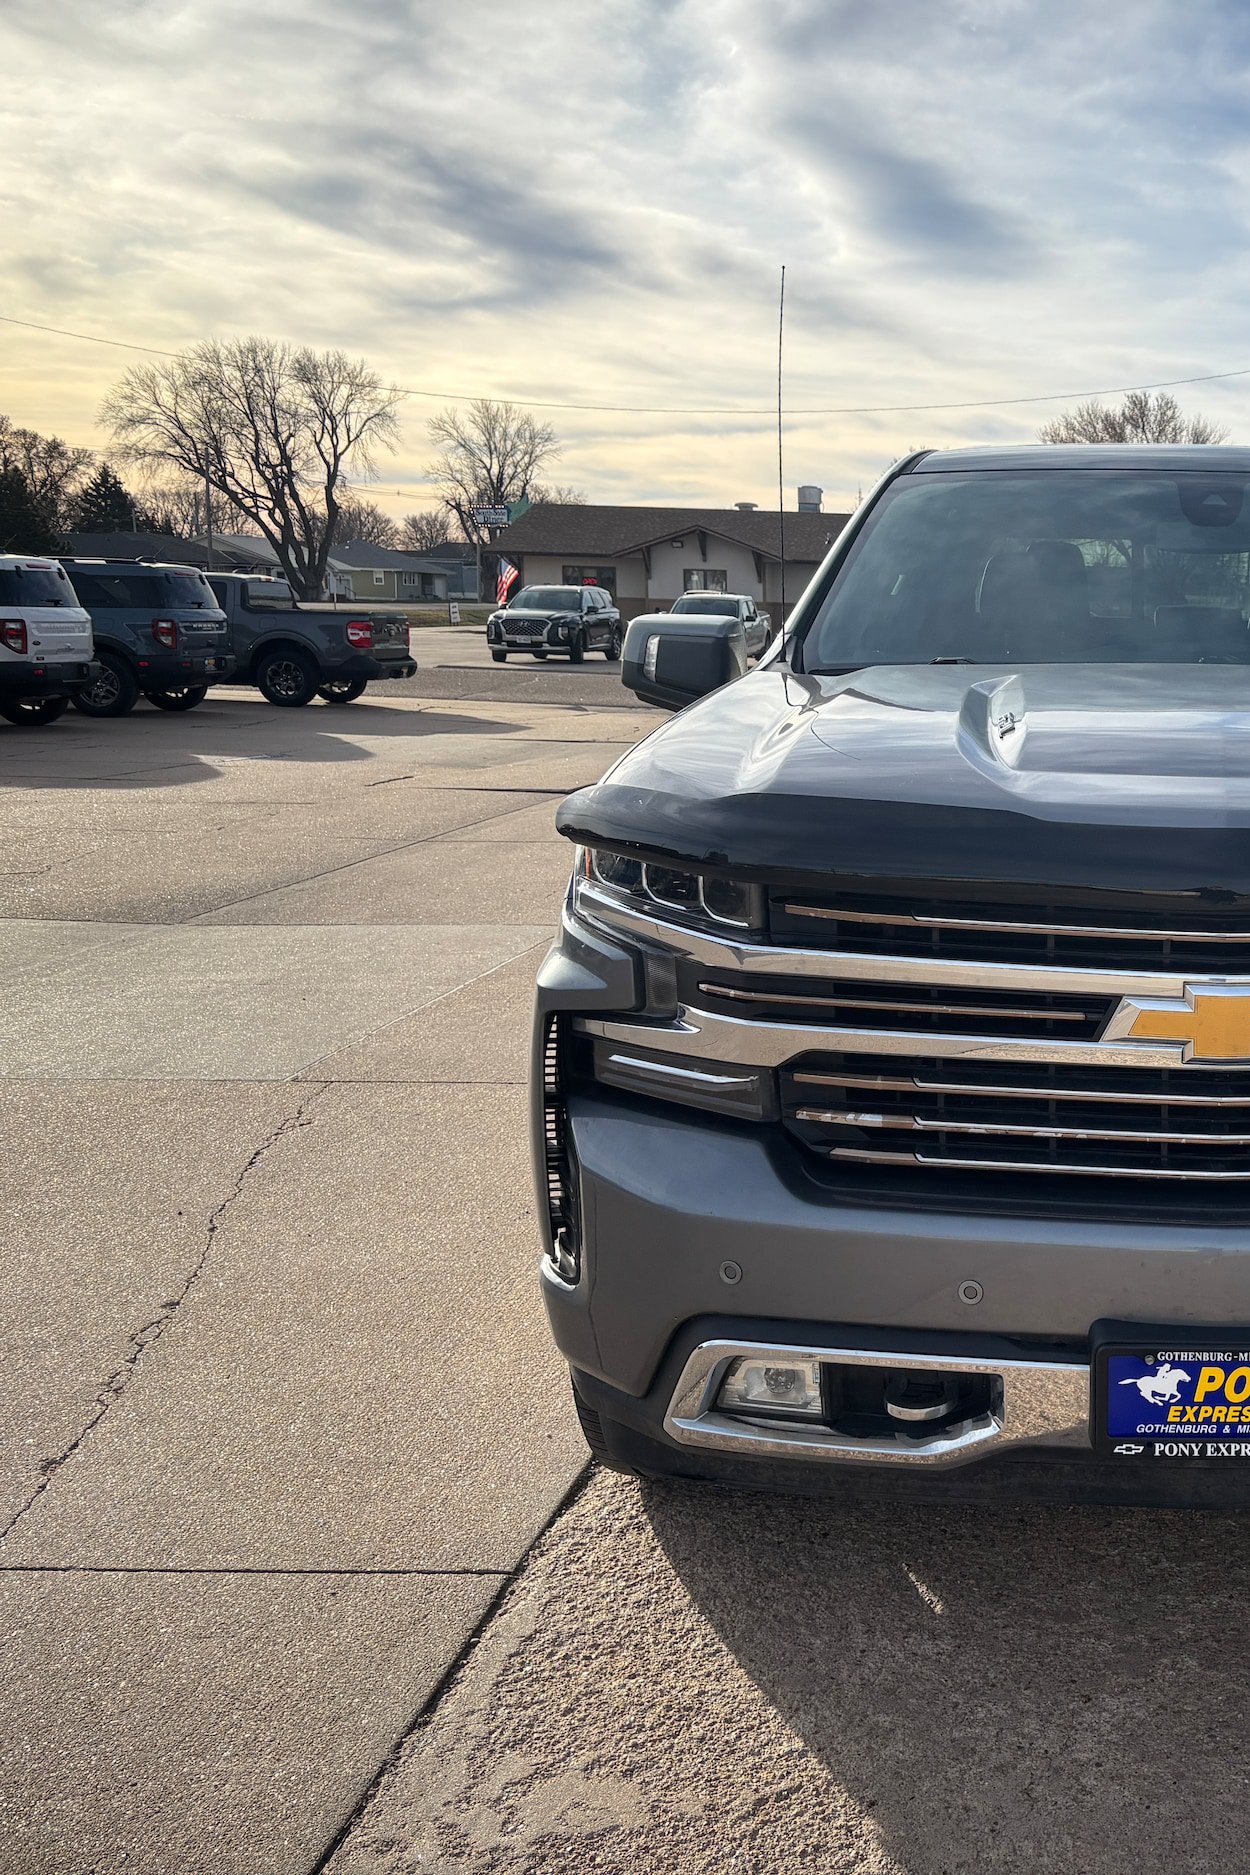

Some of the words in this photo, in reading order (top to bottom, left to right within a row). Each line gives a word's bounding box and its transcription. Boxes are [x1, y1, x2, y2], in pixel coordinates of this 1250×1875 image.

[1136, 1424, 1217, 1434] GOTHENBURG
[1222, 1425, 1231, 1434] &
[1154, 1443, 1203, 1457] PONY
